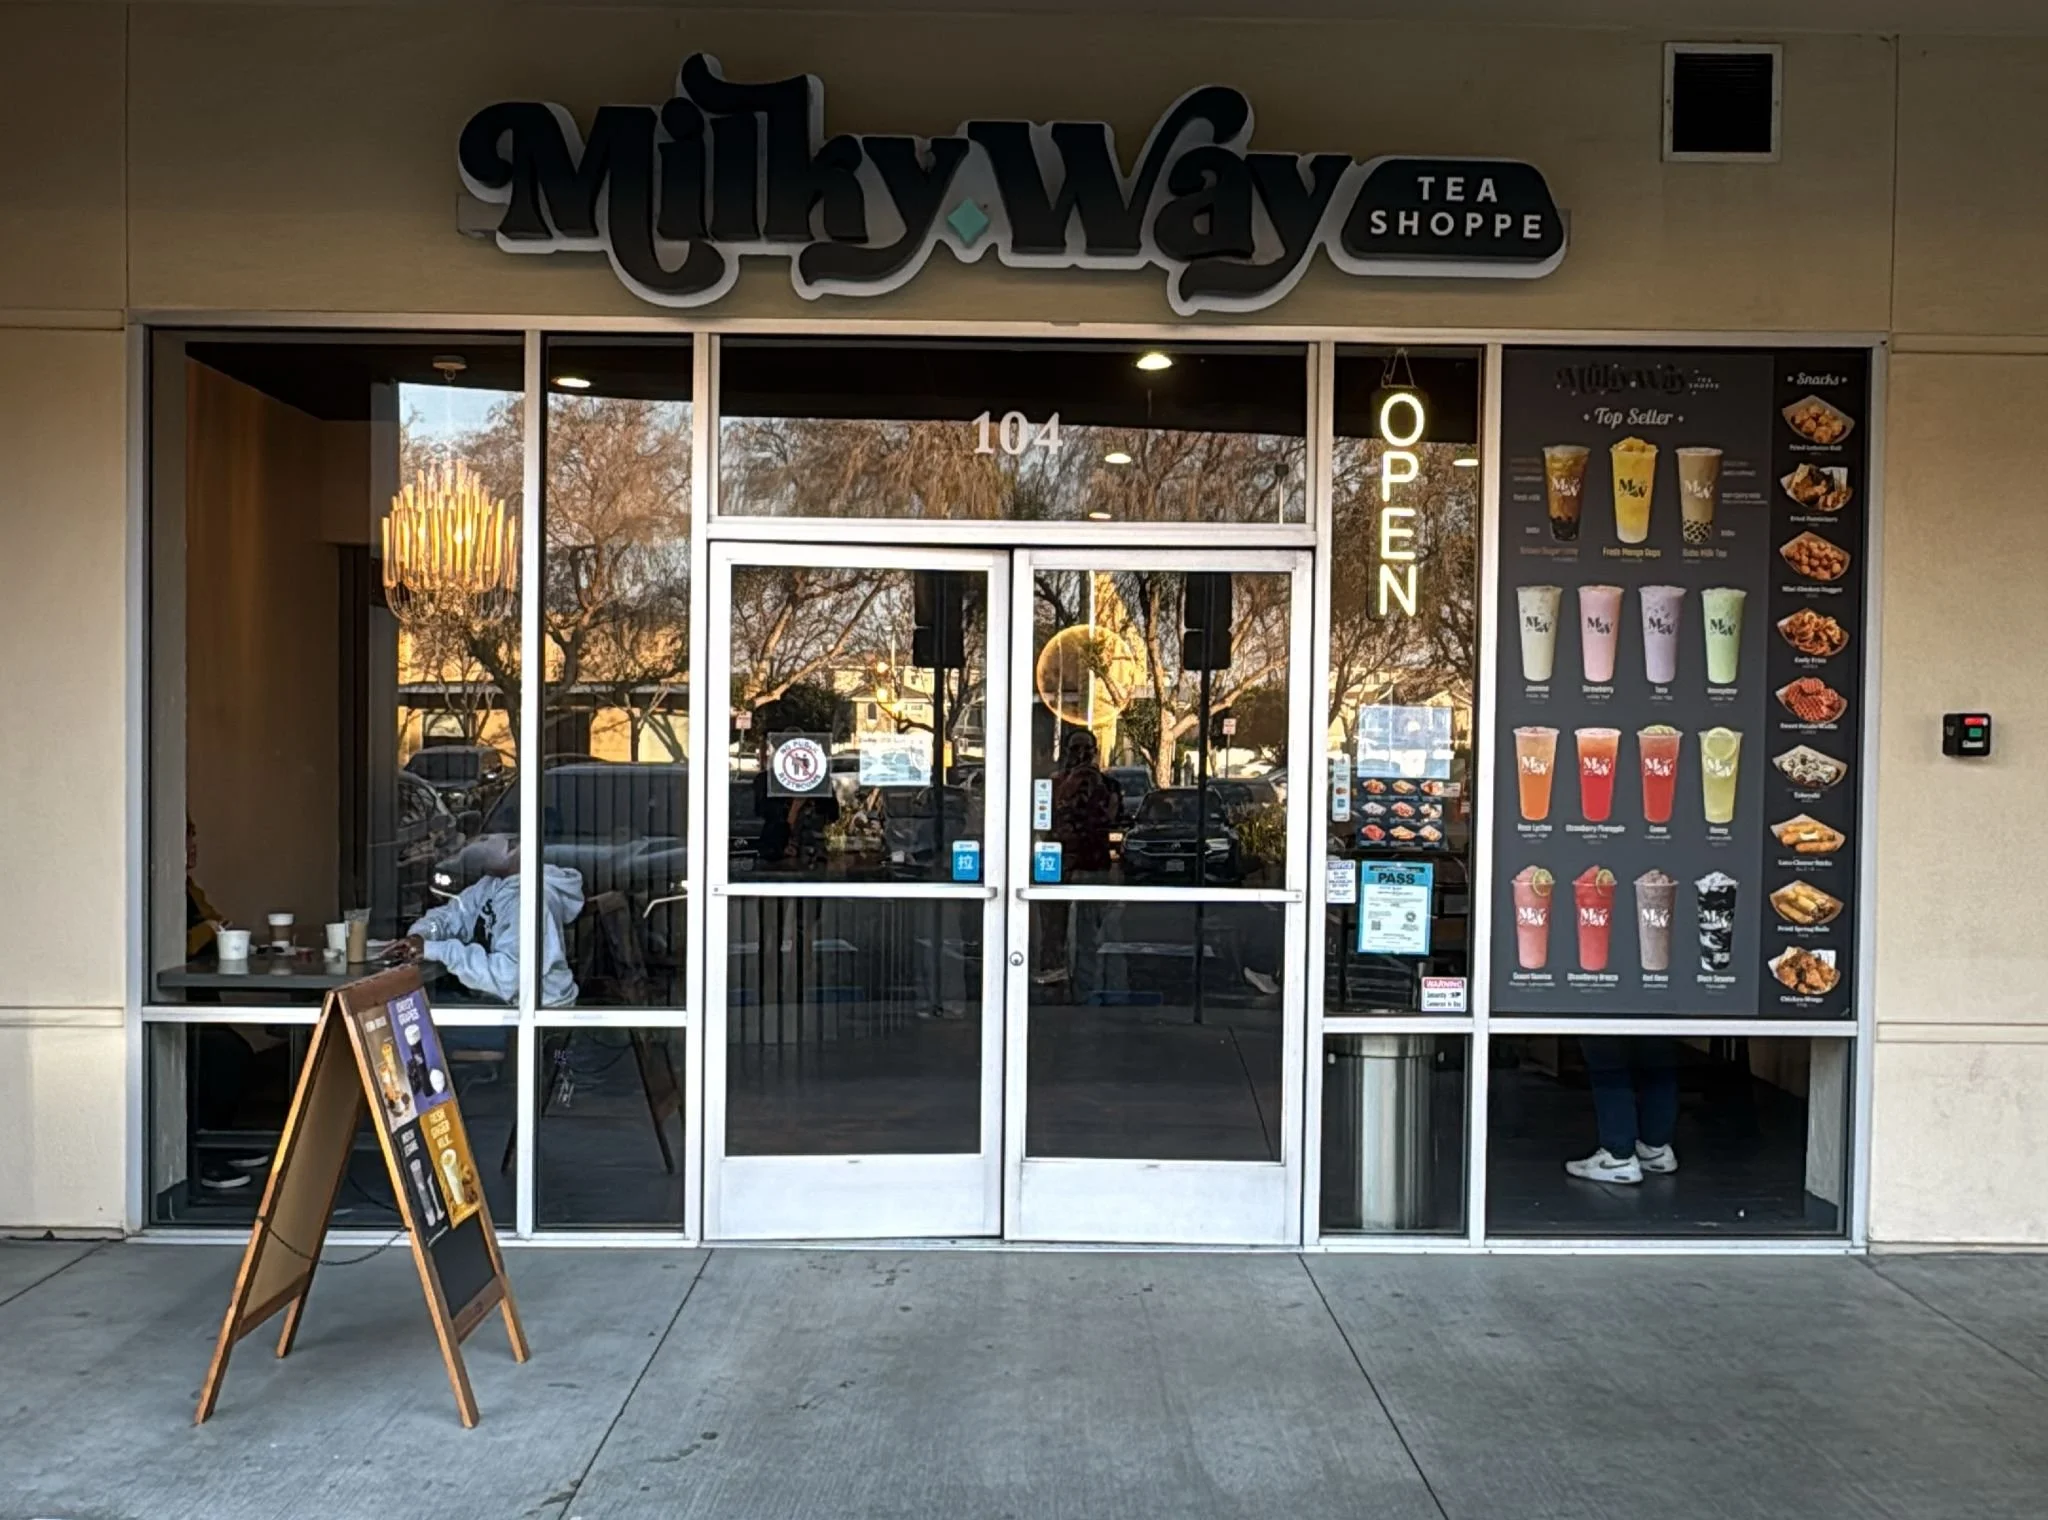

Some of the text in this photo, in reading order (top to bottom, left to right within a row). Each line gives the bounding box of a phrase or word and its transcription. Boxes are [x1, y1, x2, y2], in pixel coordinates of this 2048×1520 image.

[457, 52, 1352, 303] Milky Way
[1417, 175, 1500, 205] TEA
[1370, 208, 1545, 241] SHOPPE
[1796, 372, 1840, 386] Snacks
[972, 411, 1063, 455] 104
[1594, 407, 1674, 429] Top Seller
[1378, 392, 1426, 618] OPEN
[1377, 872, 1415, 884] PASS
[1426, 979, 1463, 988] WARNING
